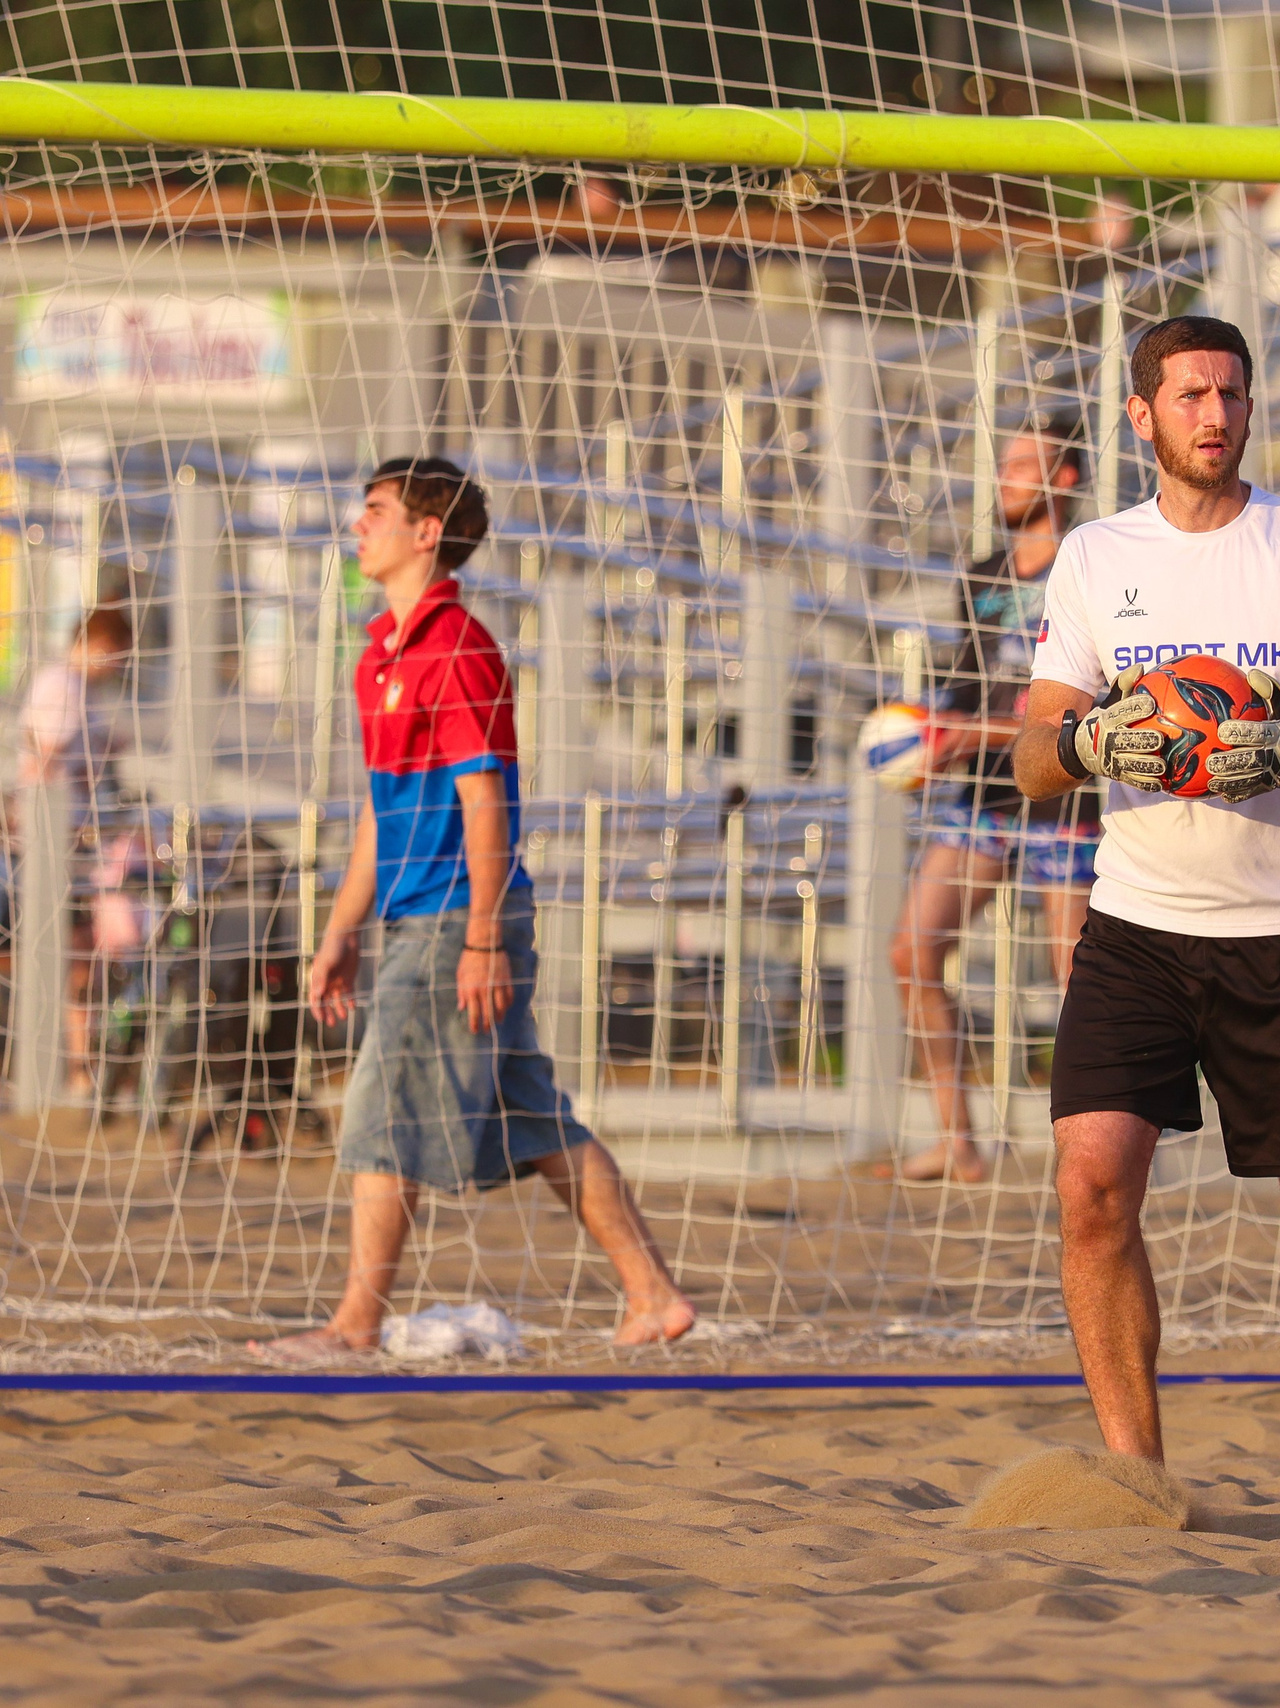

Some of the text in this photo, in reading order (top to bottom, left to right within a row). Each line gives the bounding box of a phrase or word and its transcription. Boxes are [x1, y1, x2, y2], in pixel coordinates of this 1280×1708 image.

[1113, 608, 1149, 618] JÖGEL
[1107, 703, 1143, 720] ALPHA
[1228, 728, 1274, 739] ALPHA
